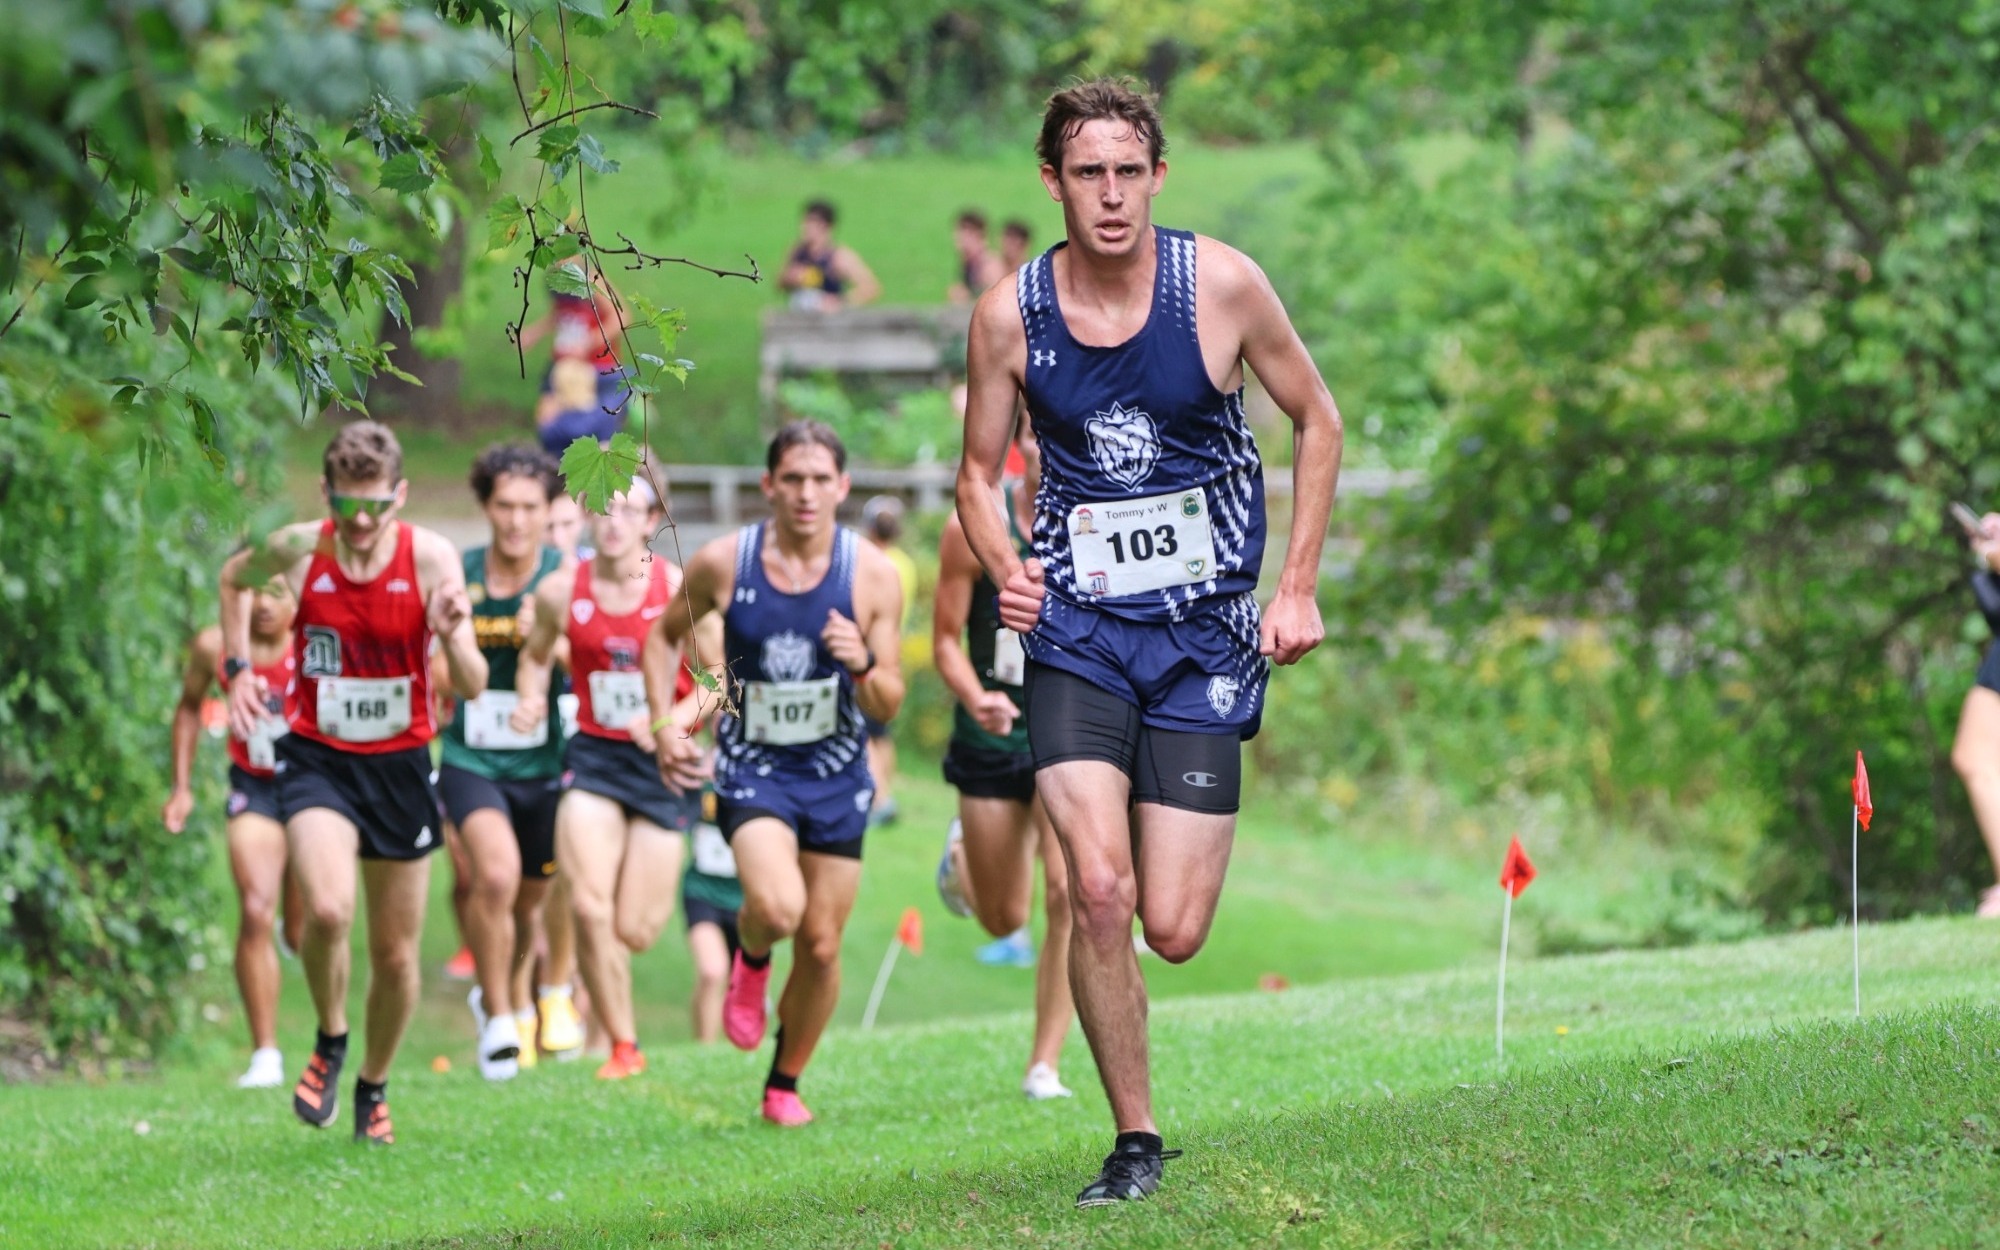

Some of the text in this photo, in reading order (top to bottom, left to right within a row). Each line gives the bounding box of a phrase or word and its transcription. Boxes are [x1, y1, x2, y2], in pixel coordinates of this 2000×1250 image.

[1105, 507, 1144, 520] Tommy
[1156, 503, 1168, 512] W
[1106, 524, 1178, 564] 103
[343, 699, 387, 720] 168
[770, 702, 814, 723] 107
